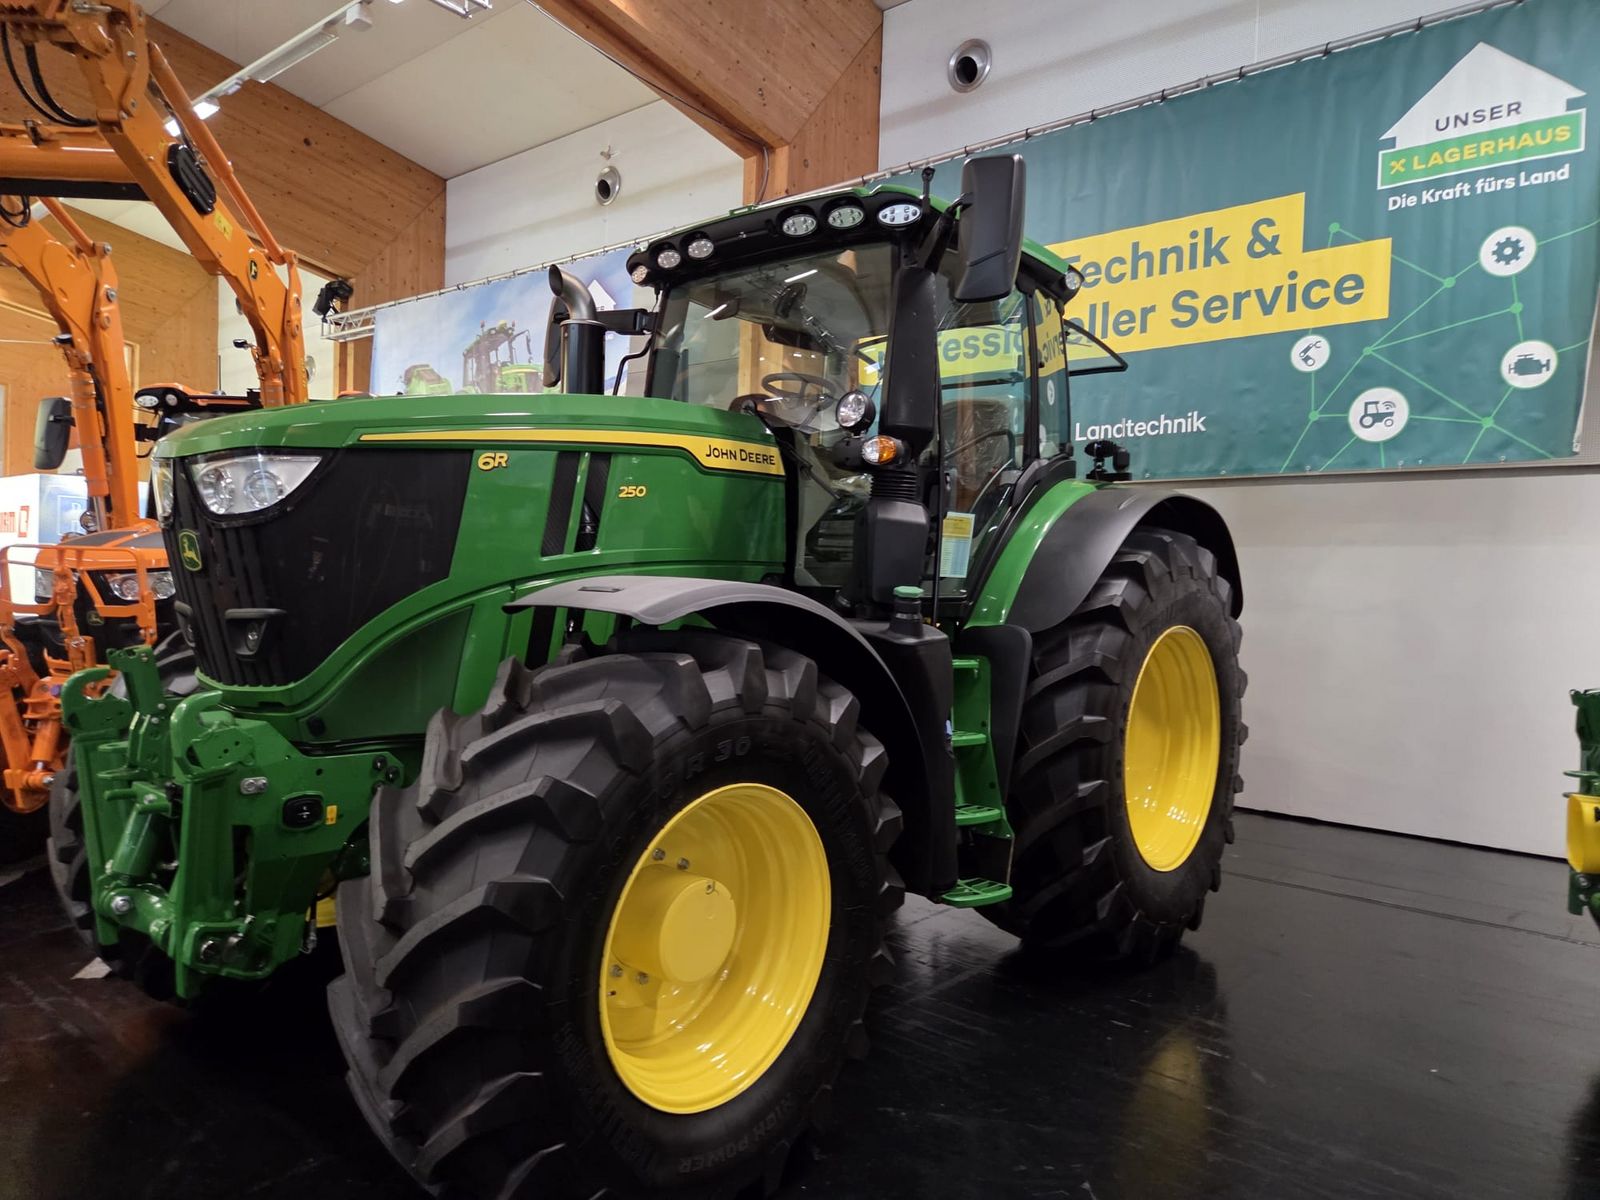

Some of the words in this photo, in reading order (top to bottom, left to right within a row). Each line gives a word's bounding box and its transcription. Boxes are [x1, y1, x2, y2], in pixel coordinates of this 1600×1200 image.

[1435, 101, 1522, 132] UNSER
[1412, 125, 1572, 171] LAGERHAUS
[1388, 193, 1418, 211] Die
[1421, 184, 1471, 205] Kraft
[1475, 176, 1516, 195] fürs
[1519, 163, 1571, 187] Land
[1246, 217, 1282, 259] &
[1170, 270, 1365, 329] Service
[1075, 411, 1207, 442] Landtechnik
[477, 452, 509, 471] 6R
[705, 444, 738, 461] JOHN
[739, 447, 777, 466] DEERE
[618, 485, 647, 498] 250
[714, 736, 751, 762] 30
[679, 1134, 749, 1174] POWER
